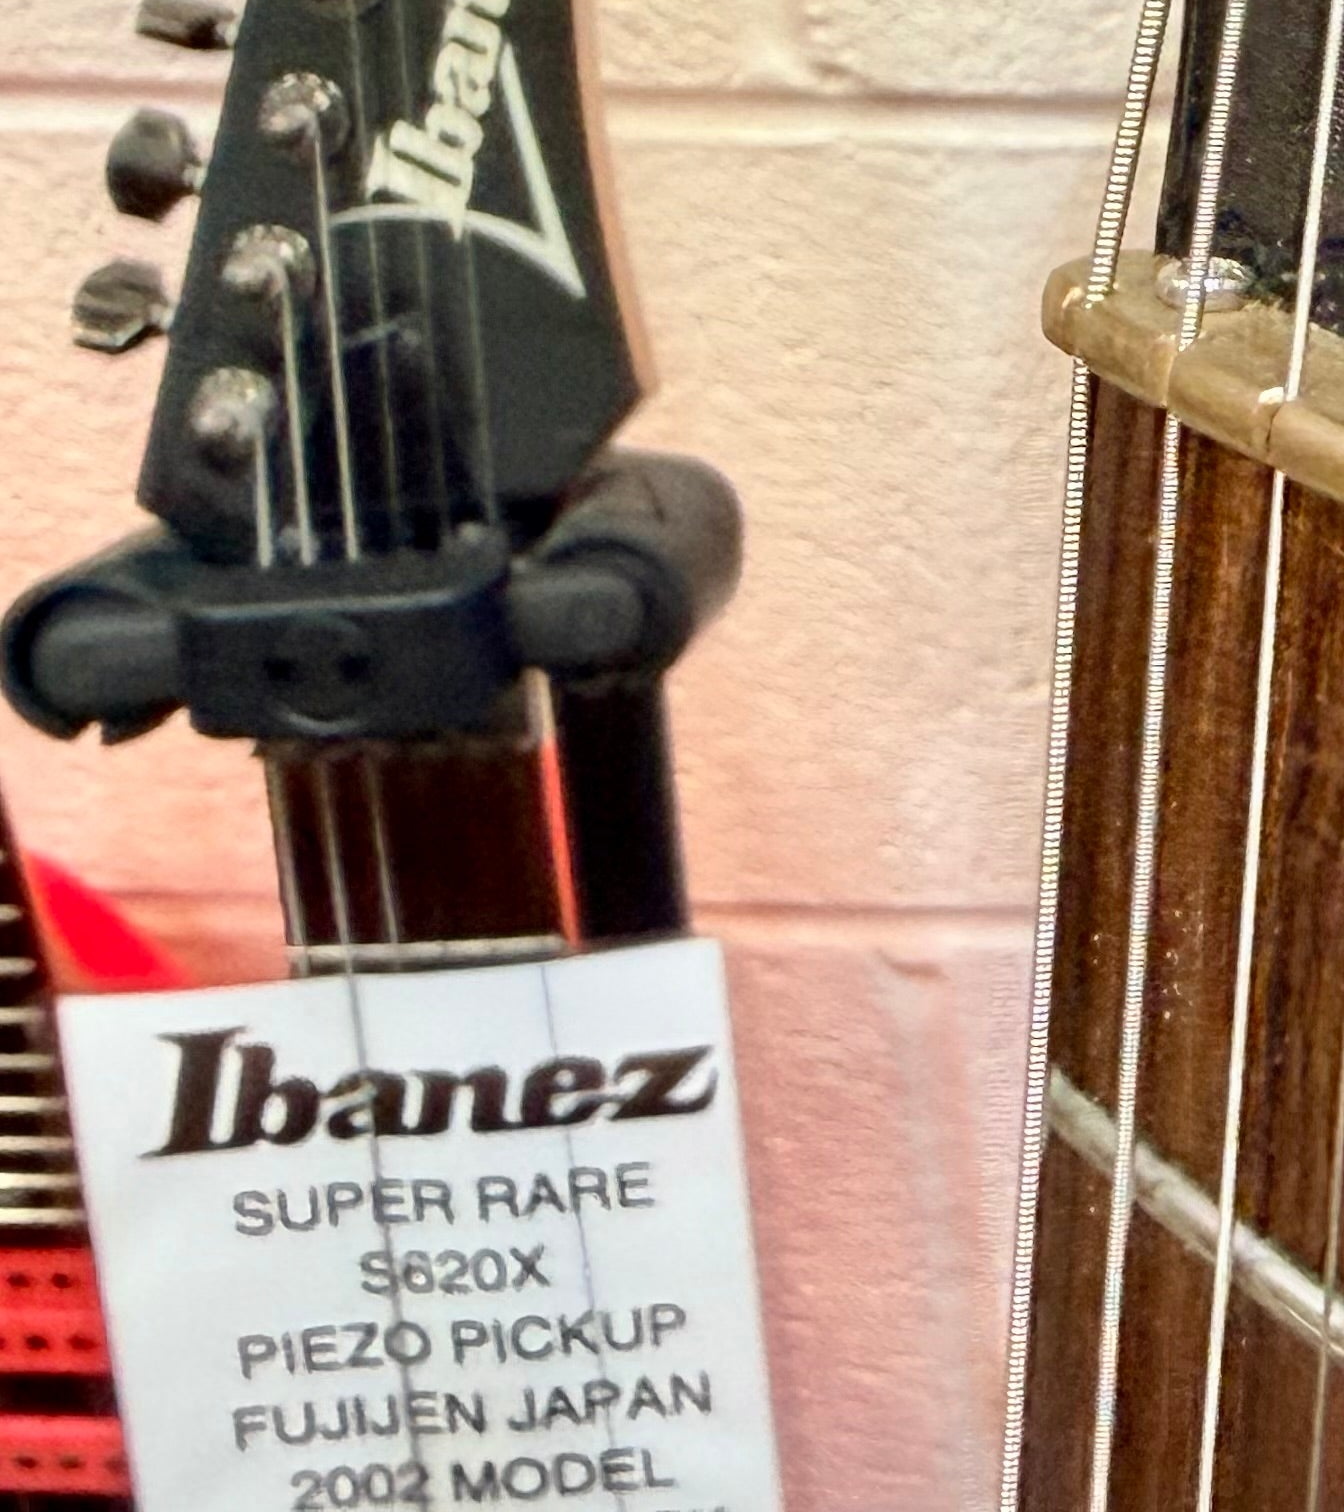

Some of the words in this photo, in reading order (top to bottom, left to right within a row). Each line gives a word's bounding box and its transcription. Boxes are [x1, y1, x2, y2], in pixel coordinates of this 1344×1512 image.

[138, 1025, 719, 1160] Ibanez
[233, 1177, 454, 1236] SUPER
[477, 1162, 655, 1222] RARE
[360, 1244, 550, 1295] S620X
[237, 1320, 432, 1379] PIEZO
[451, 1303, 686, 1364] PICKUP
[233, 1391, 487, 1451] FUJIJEN
[507, 1370, 712, 1432] JAPAN
[291, 1462, 429, 1511] 2002
[451, 1448, 673, 1501] MODEL
